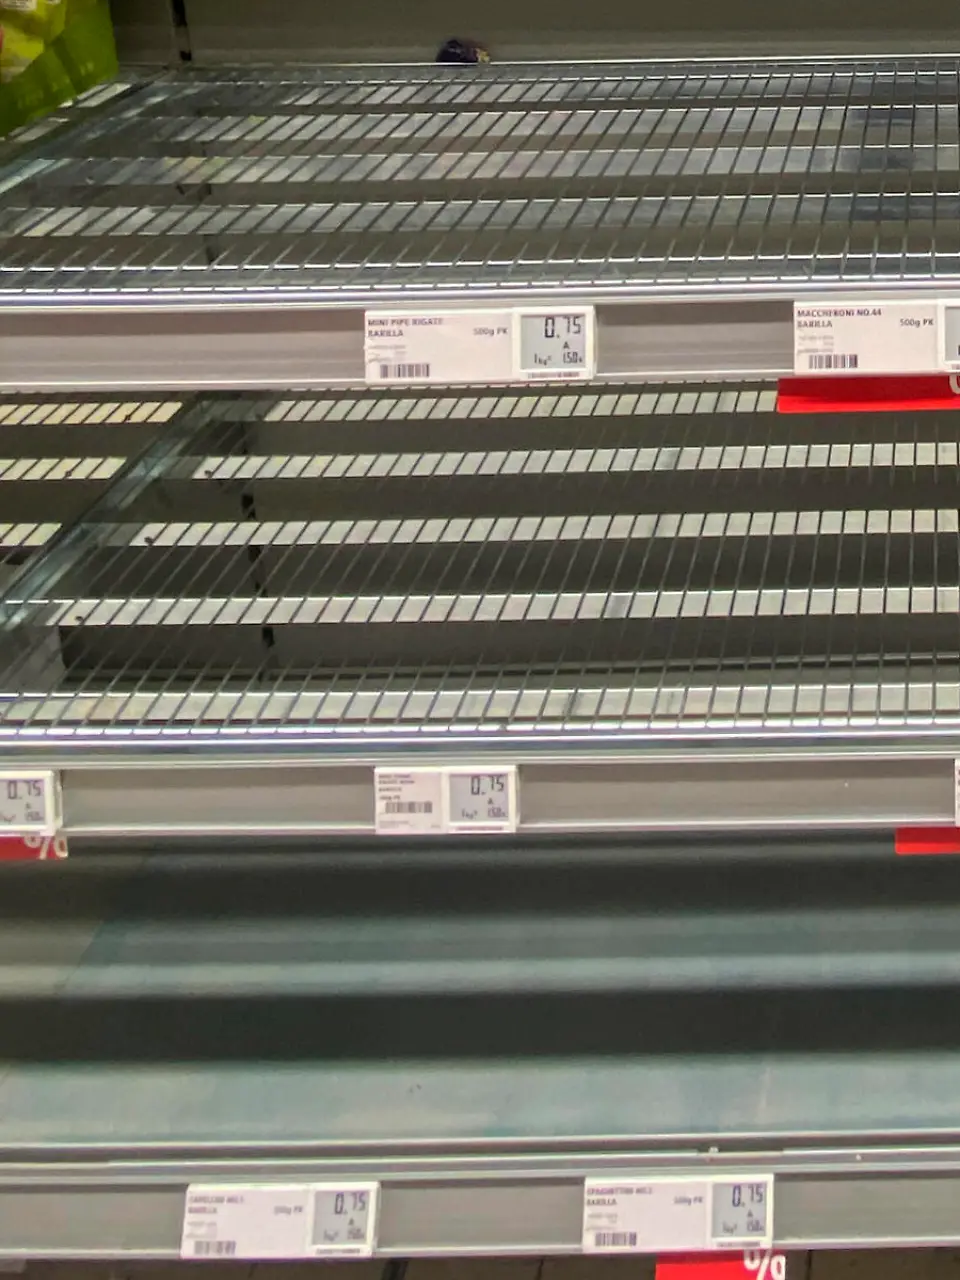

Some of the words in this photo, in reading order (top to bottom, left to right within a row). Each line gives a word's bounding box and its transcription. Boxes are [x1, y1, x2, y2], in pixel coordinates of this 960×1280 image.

[797, 308, 855, 317] MACCHERONI
[900, 318, 921, 328] 500g
[923, 318, 934, 326] PK
[544, 316, 582, 339] 0.75
[470, 775, 505, 796] 0.75
[334, 1191, 366, 1215] 0.75
[731, 1184, 764, 1208] 0.75
